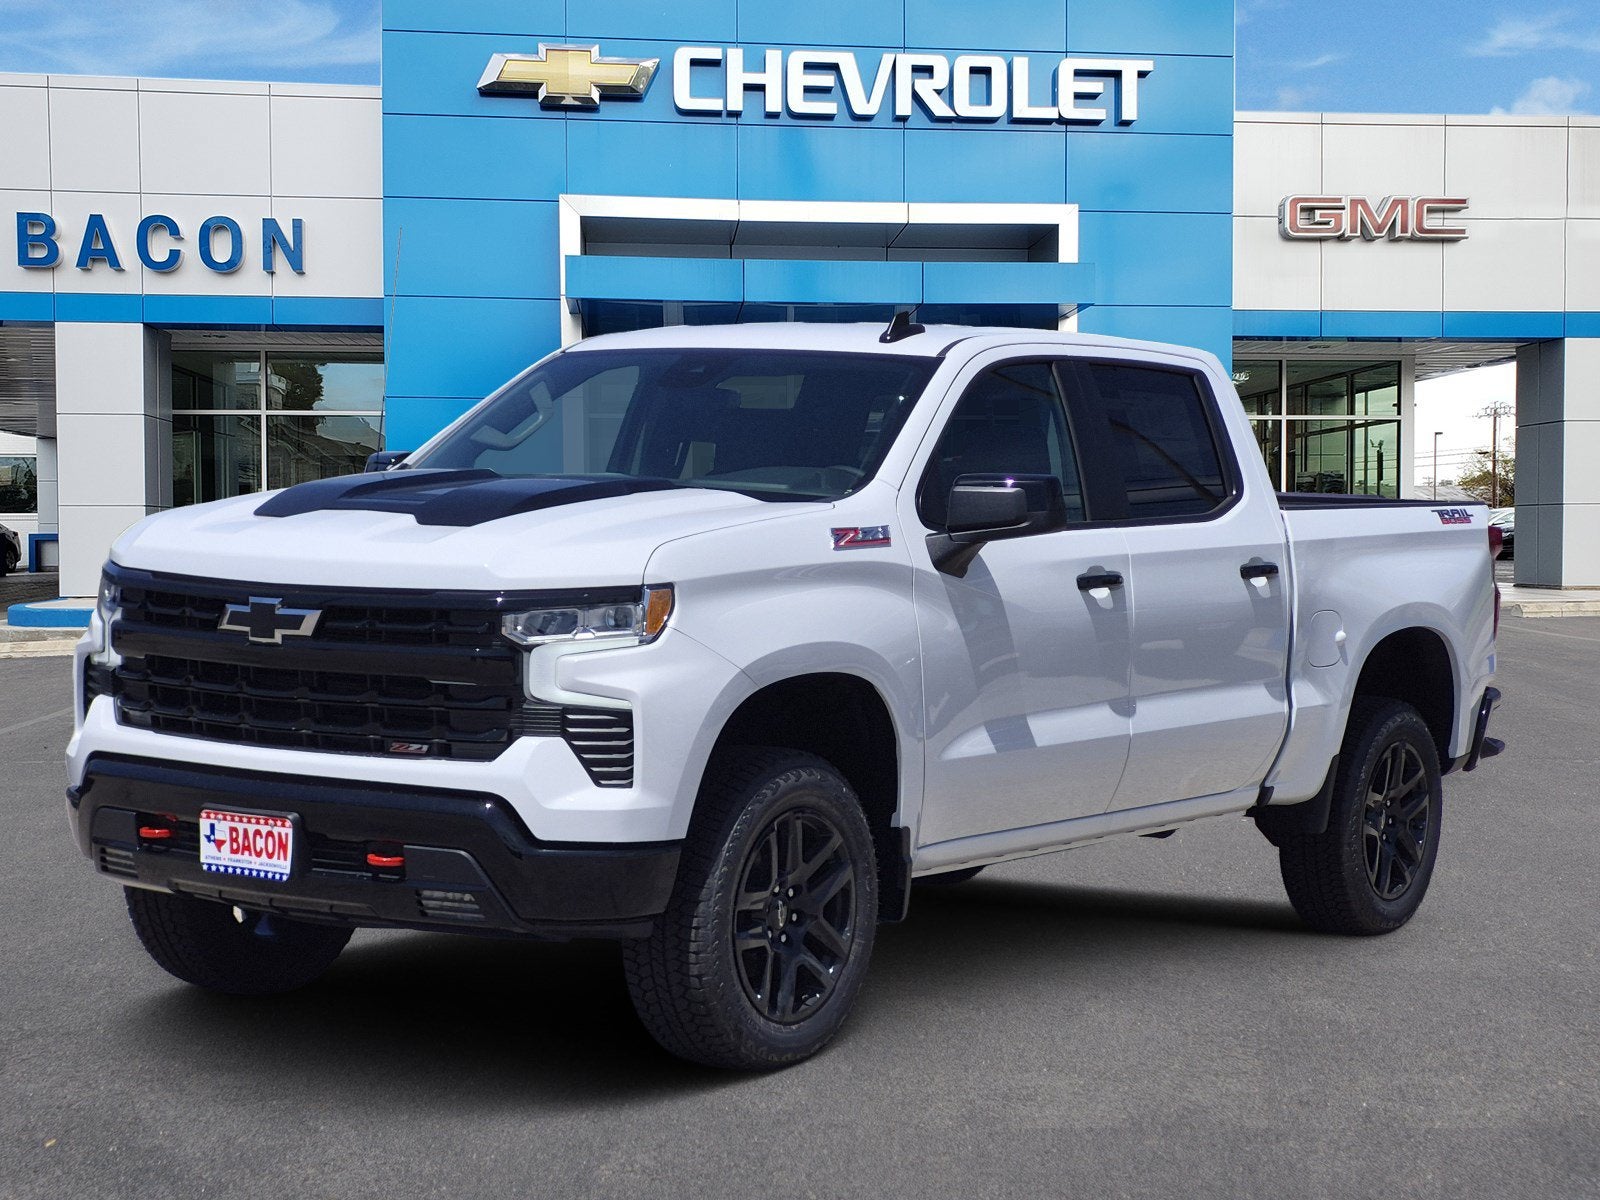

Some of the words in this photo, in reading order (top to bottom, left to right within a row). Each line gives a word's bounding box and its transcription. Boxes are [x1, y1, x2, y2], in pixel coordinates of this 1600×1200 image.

[673, 46, 1155, 126] CHEVROLET
[1279, 194, 1470, 242] GMC
[16, 211, 306, 275] BACON
[1431, 508, 1474, 518] TRAIL
[1440, 517, 1472, 525] BOSS
[830, 525, 892, 551] Z71
[389, 742, 430, 754] Z71
[228, 826, 289, 861] BACON
